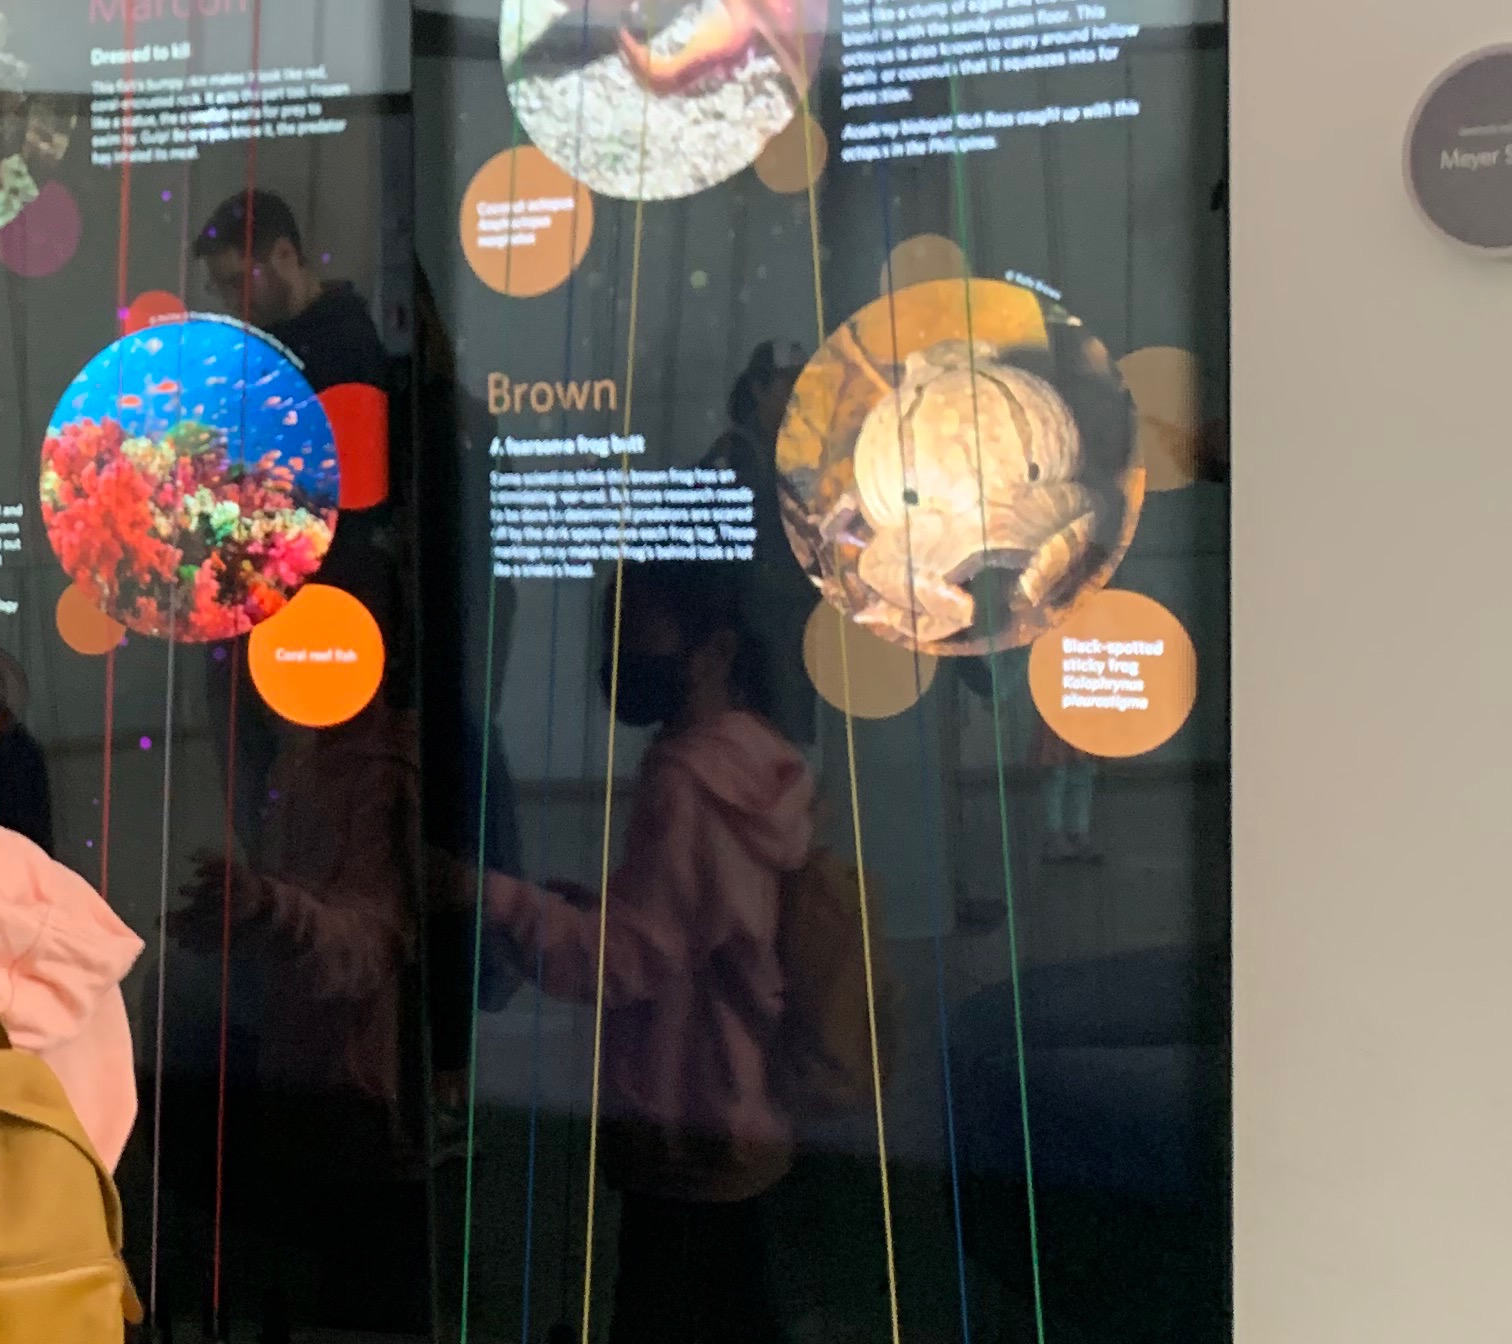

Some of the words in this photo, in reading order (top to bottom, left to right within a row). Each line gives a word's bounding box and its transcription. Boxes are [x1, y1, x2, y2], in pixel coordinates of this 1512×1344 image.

[488, 372, 617, 415] Brown
[1062, 636, 1164, 656] Black-spotted
[1108, 659, 1140, 676] frog
